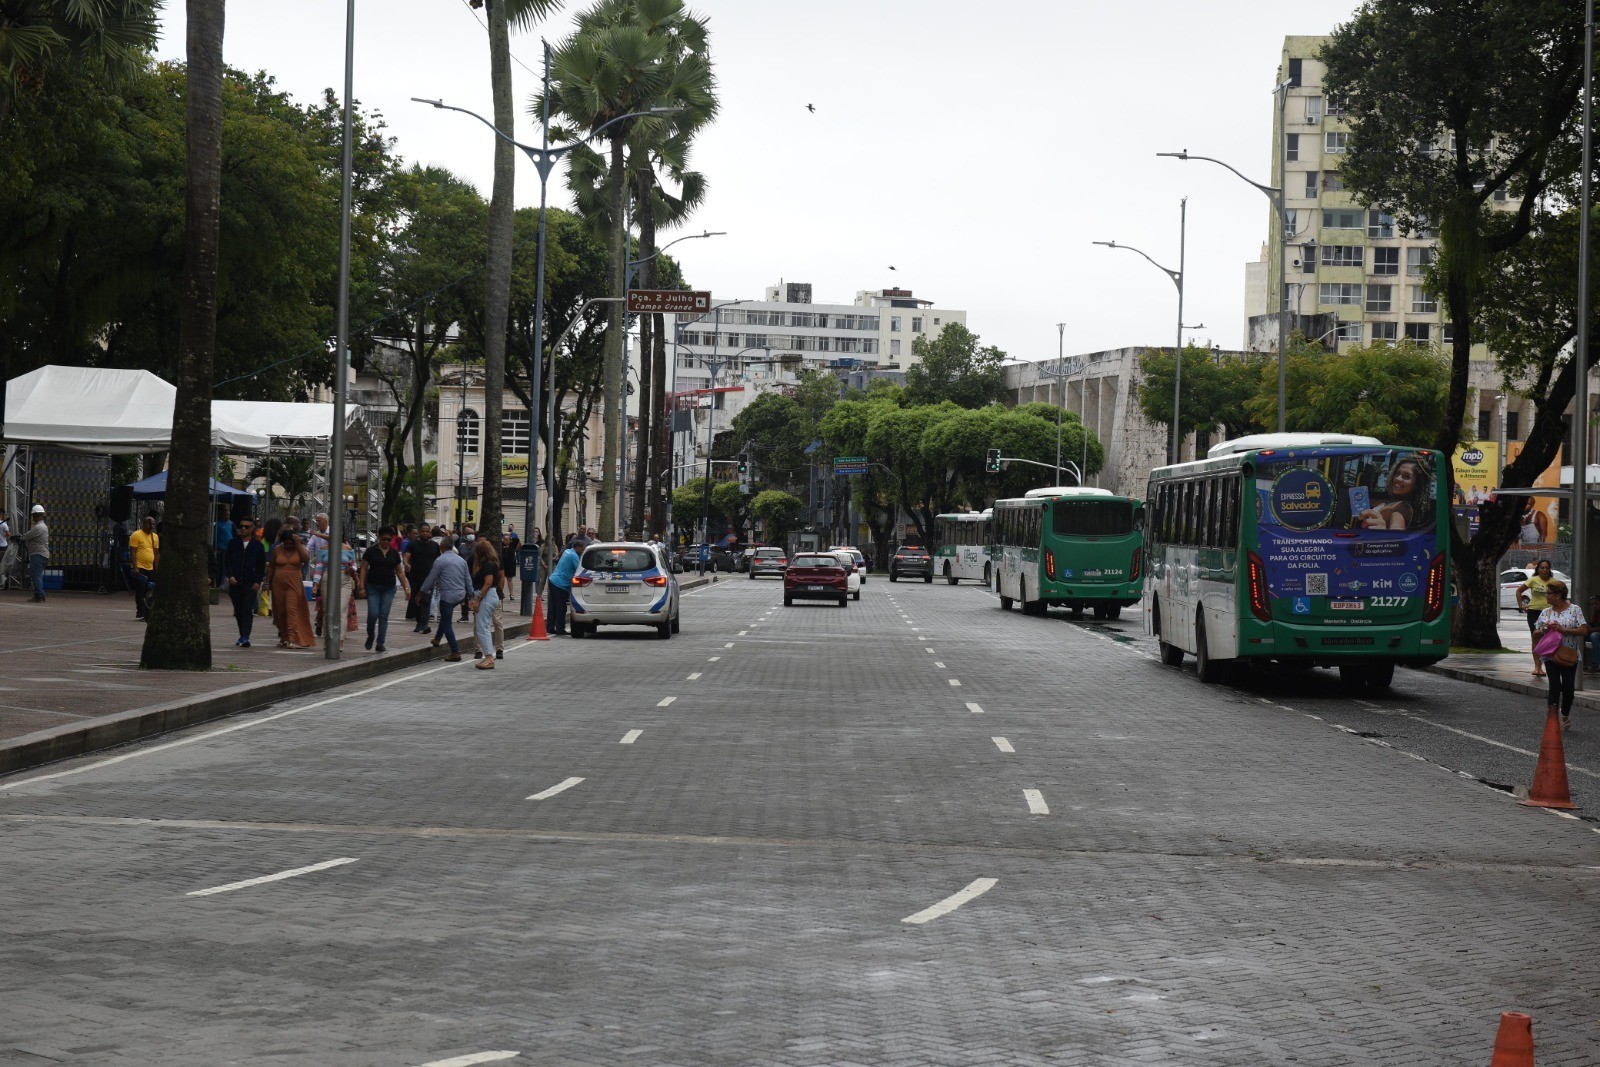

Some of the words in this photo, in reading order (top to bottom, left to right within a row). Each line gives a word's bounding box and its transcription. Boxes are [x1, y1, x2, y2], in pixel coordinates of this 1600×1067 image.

[631, 293, 652, 303] Pça.
[656, 294, 662, 302] 2
[635, 303, 662, 311] Campo
[1463, 451, 1483, 460] mpb
[1281, 501, 1321, 511] Salvador
[1272, 538, 1333, 546] TRANSPORTANDO
[1294, 545, 1325, 553] ALEGRIA
[1372, 578, 1393, 588] KiM
[1370, 596, 1409, 607] 21277
